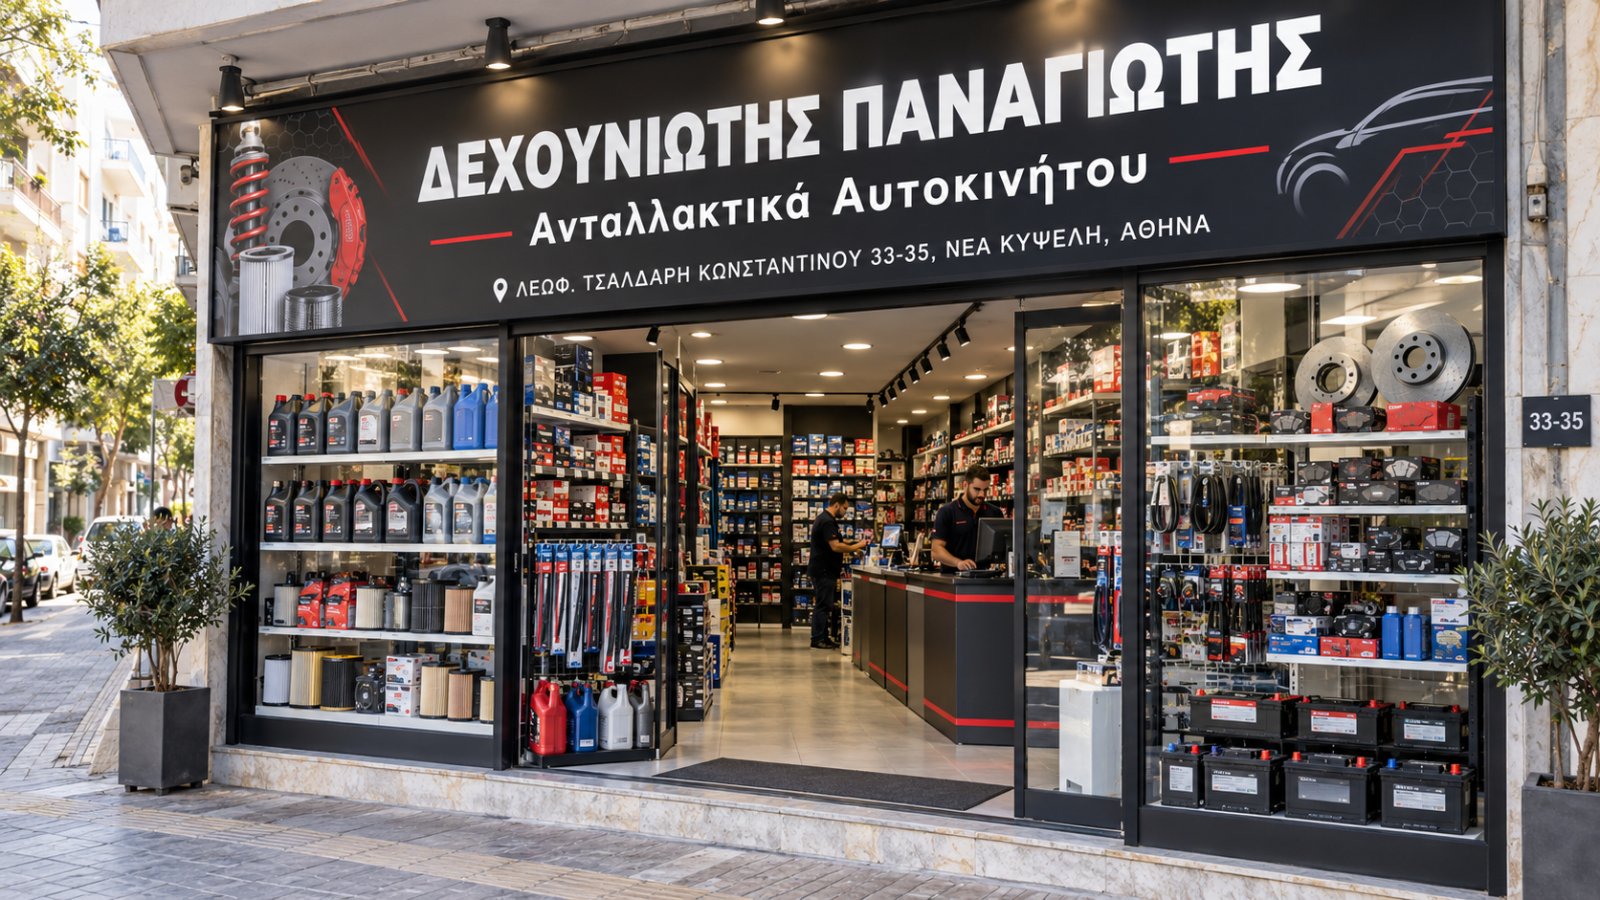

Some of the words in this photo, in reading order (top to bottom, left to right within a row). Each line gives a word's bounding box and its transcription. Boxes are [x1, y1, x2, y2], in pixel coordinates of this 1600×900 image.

[417, 93, 821, 204] ΔΕΧΟΥΝΙΩΤΗΣ
[842, 13, 1323, 152] ΠΑΝΑΓΙΩΤΗΣ
[528, 181, 810, 247] Ανταλλακτικά
[831, 152, 1147, 216] Αυτοκινήτου
[515, 276, 575, 298] ΛΕΩΦ.
[582, 265, 690, 292] ΤΣΑΛΔΑΡΗ
[699, 248, 862, 282] ΚΩΝΣΤΑΝΤΙΝΟΥ
[870, 242, 936, 266] 33-35,
[946, 236, 991, 259] ΝΕΑ
[1000, 224, 1109, 254] ΚΥΨΕΛΗ,
[1120, 213, 1211, 242] ΑΘΗΝΑ
[1529, 411, 1584, 431] 33-35
